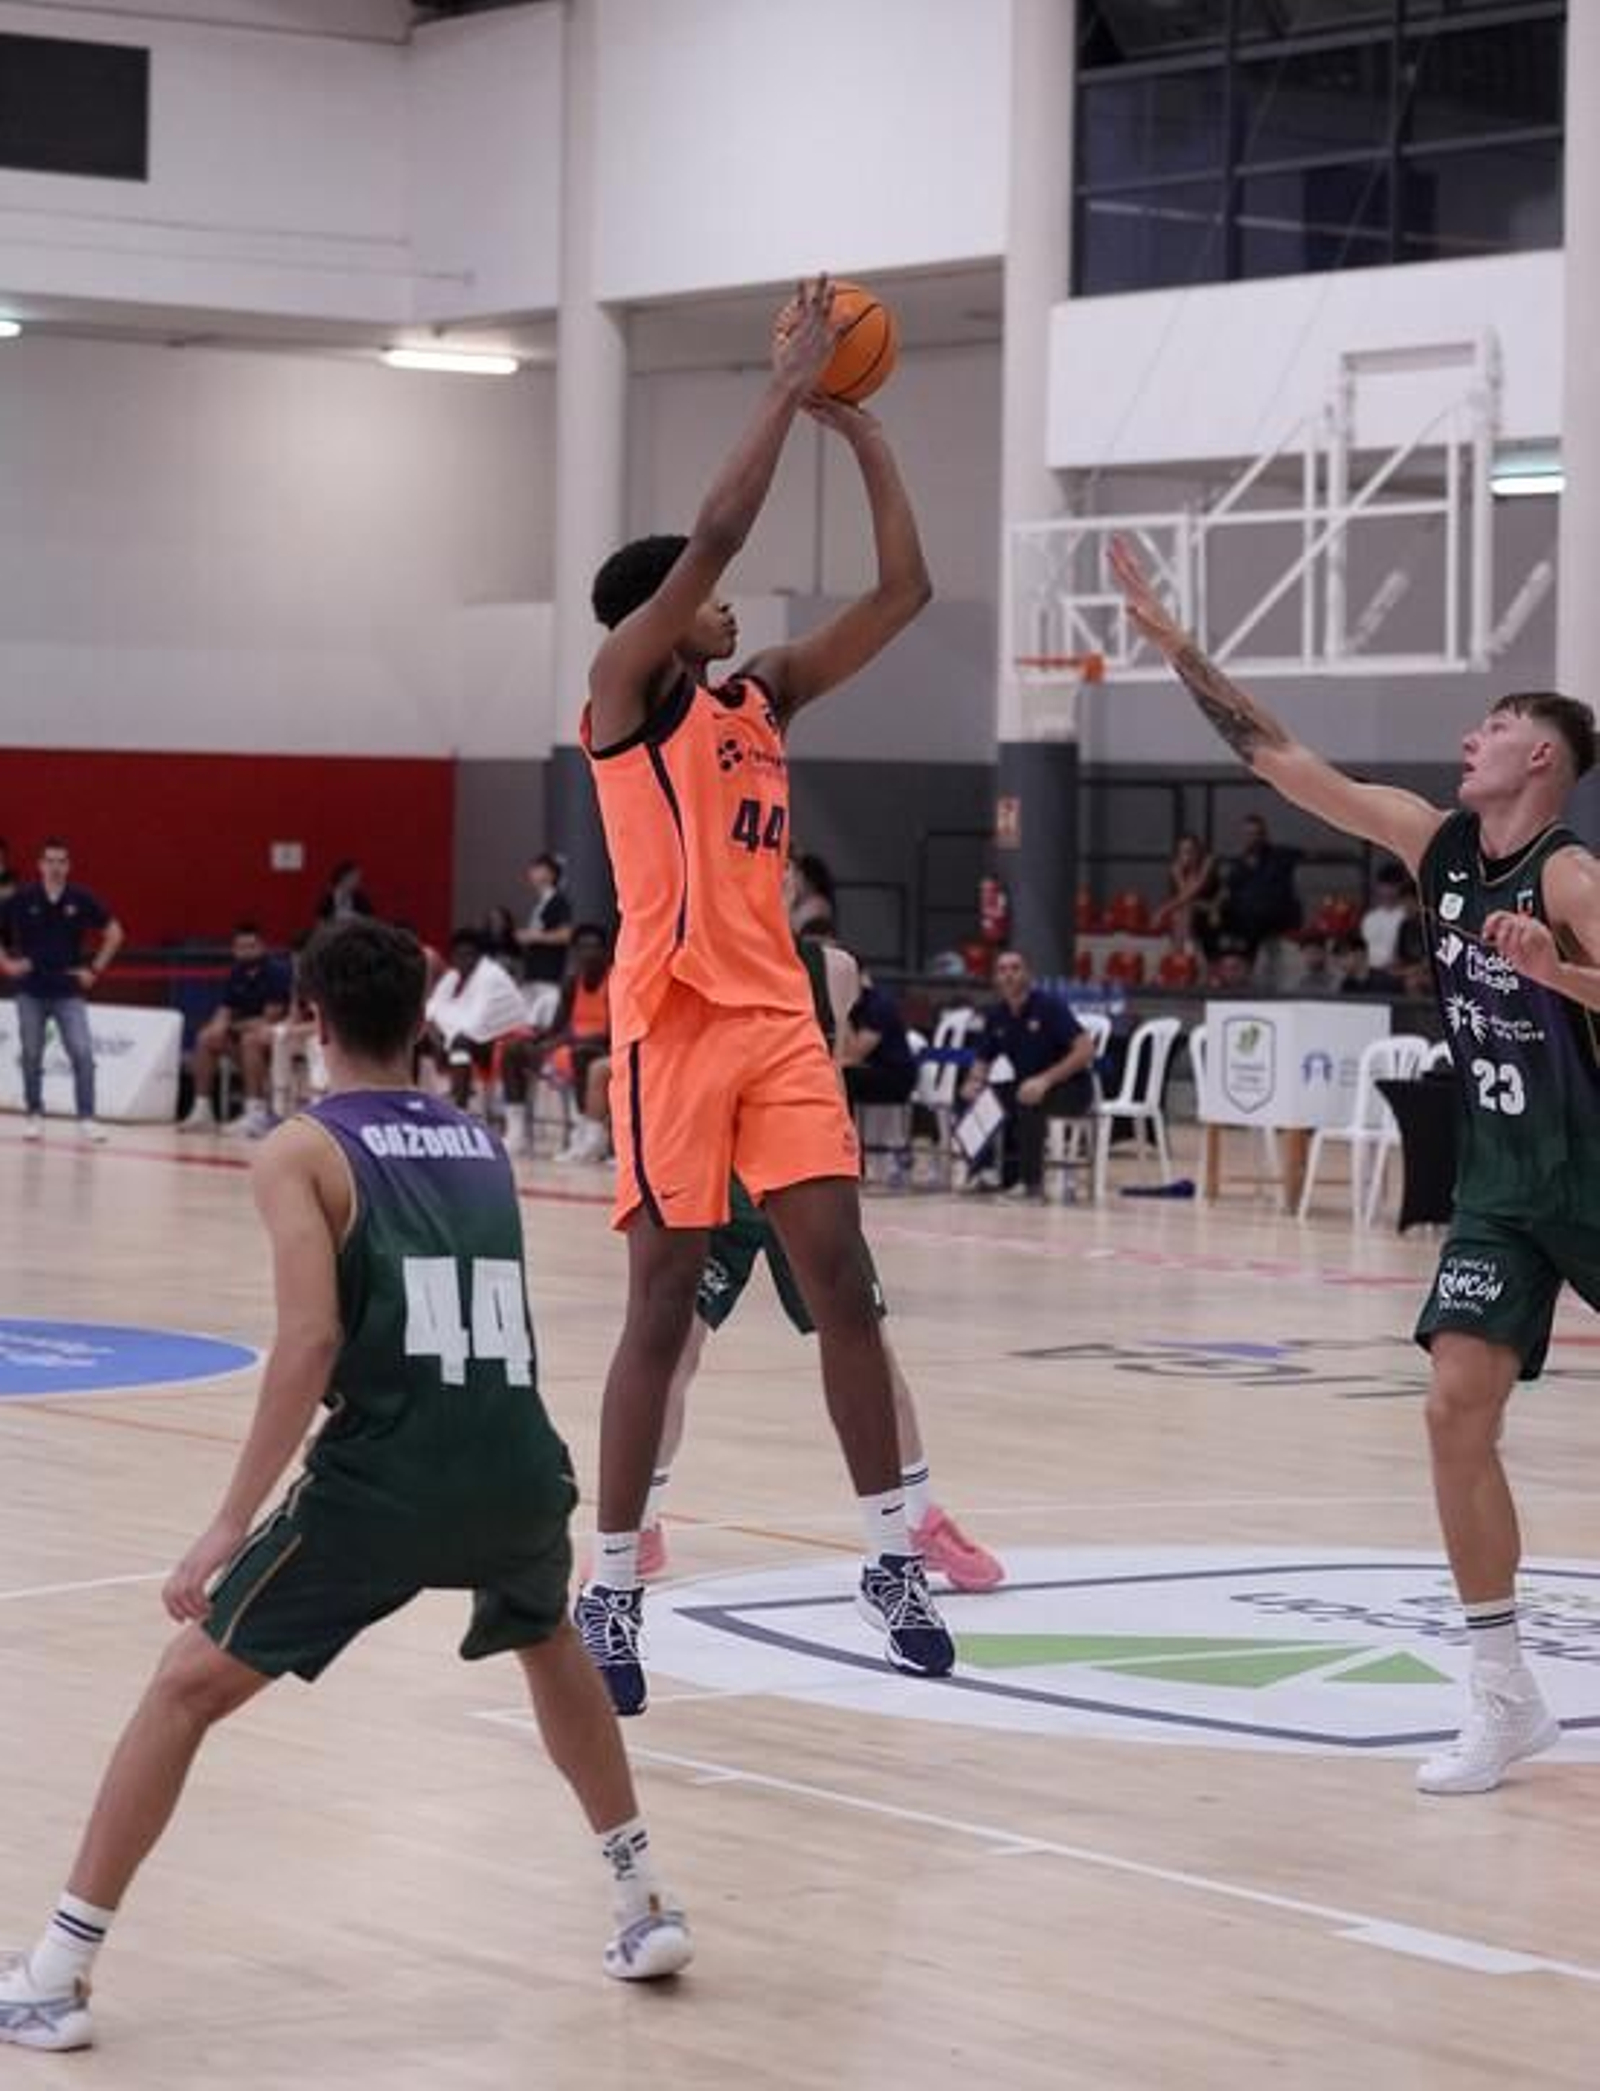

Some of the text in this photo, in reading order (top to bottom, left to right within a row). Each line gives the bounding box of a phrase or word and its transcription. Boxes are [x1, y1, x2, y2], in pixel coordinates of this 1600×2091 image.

[732, 799, 785, 853] 44
[1471, 1058, 1525, 1115] 23
[360, 1124, 496, 1160] CAZORLA
[403, 1256, 532, 1386] 44
